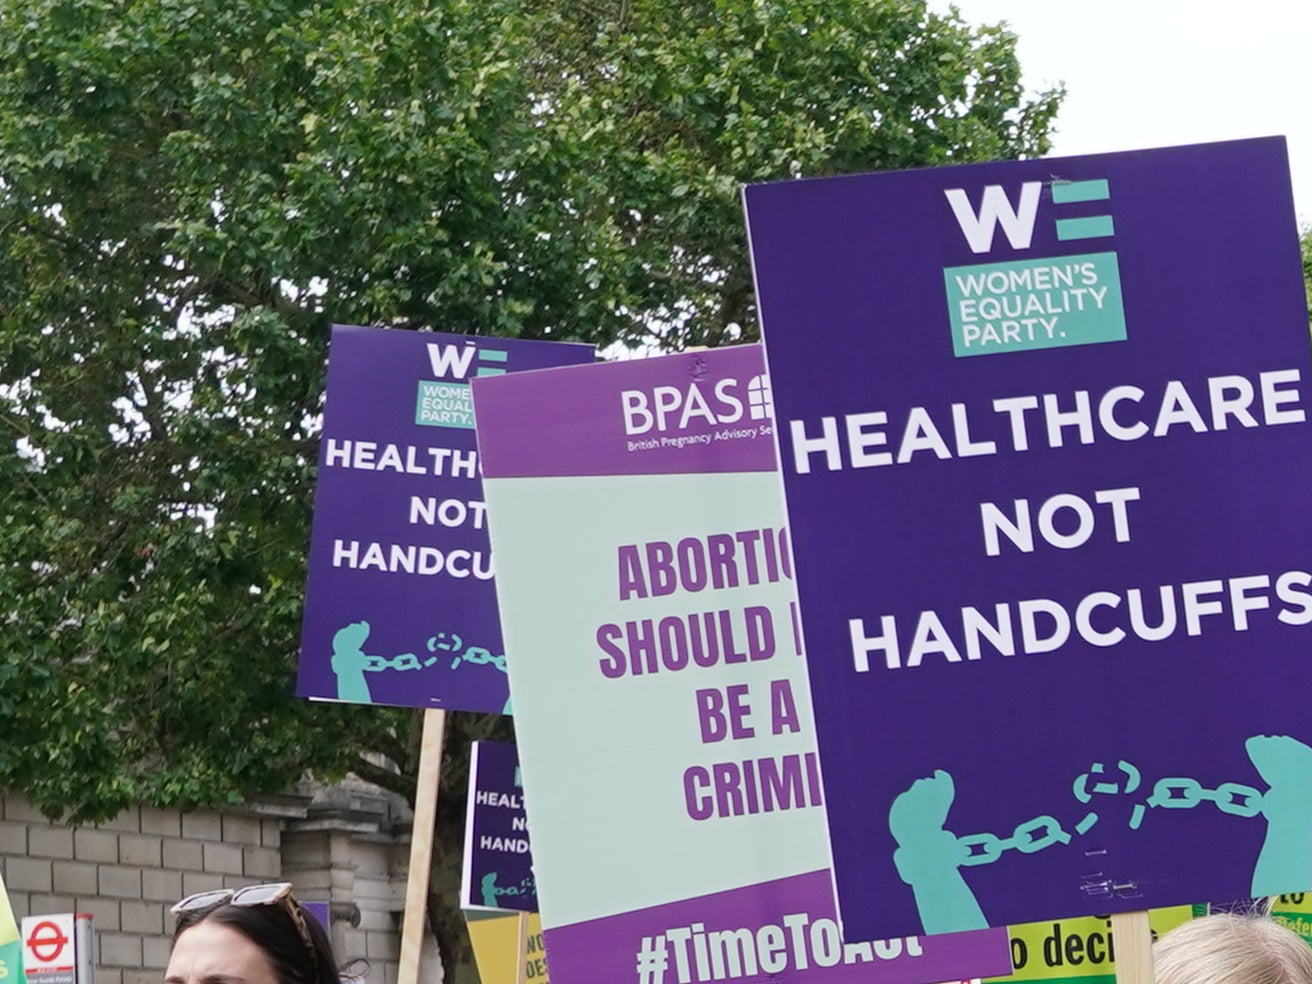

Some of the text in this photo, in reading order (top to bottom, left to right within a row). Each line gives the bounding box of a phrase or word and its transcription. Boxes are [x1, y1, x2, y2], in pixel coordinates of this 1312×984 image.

[956, 262, 1099, 298] WOMEN'S
[959, 286, 1108, 324] EQUALITY
[962, 316, 1067, 348] PARTY.
[621, 378, 744, 436] BPAS
[790, 369, 1307, 474] HEALTHCARE
[627, 437, 660, 452] British
[661, 430, 712, 450] Pregnancy
[714, 425, 759, 443] Advisory
[326, 438, 483, 479] HEALTH
[409, 496, 488, 530] NOT
[980, 487, 1141, 557] NOT
[596, 604, 776, 680] SHOULD
[695, 679, 802, 744] BE A
[476, 790, 525, 809] HEAL
